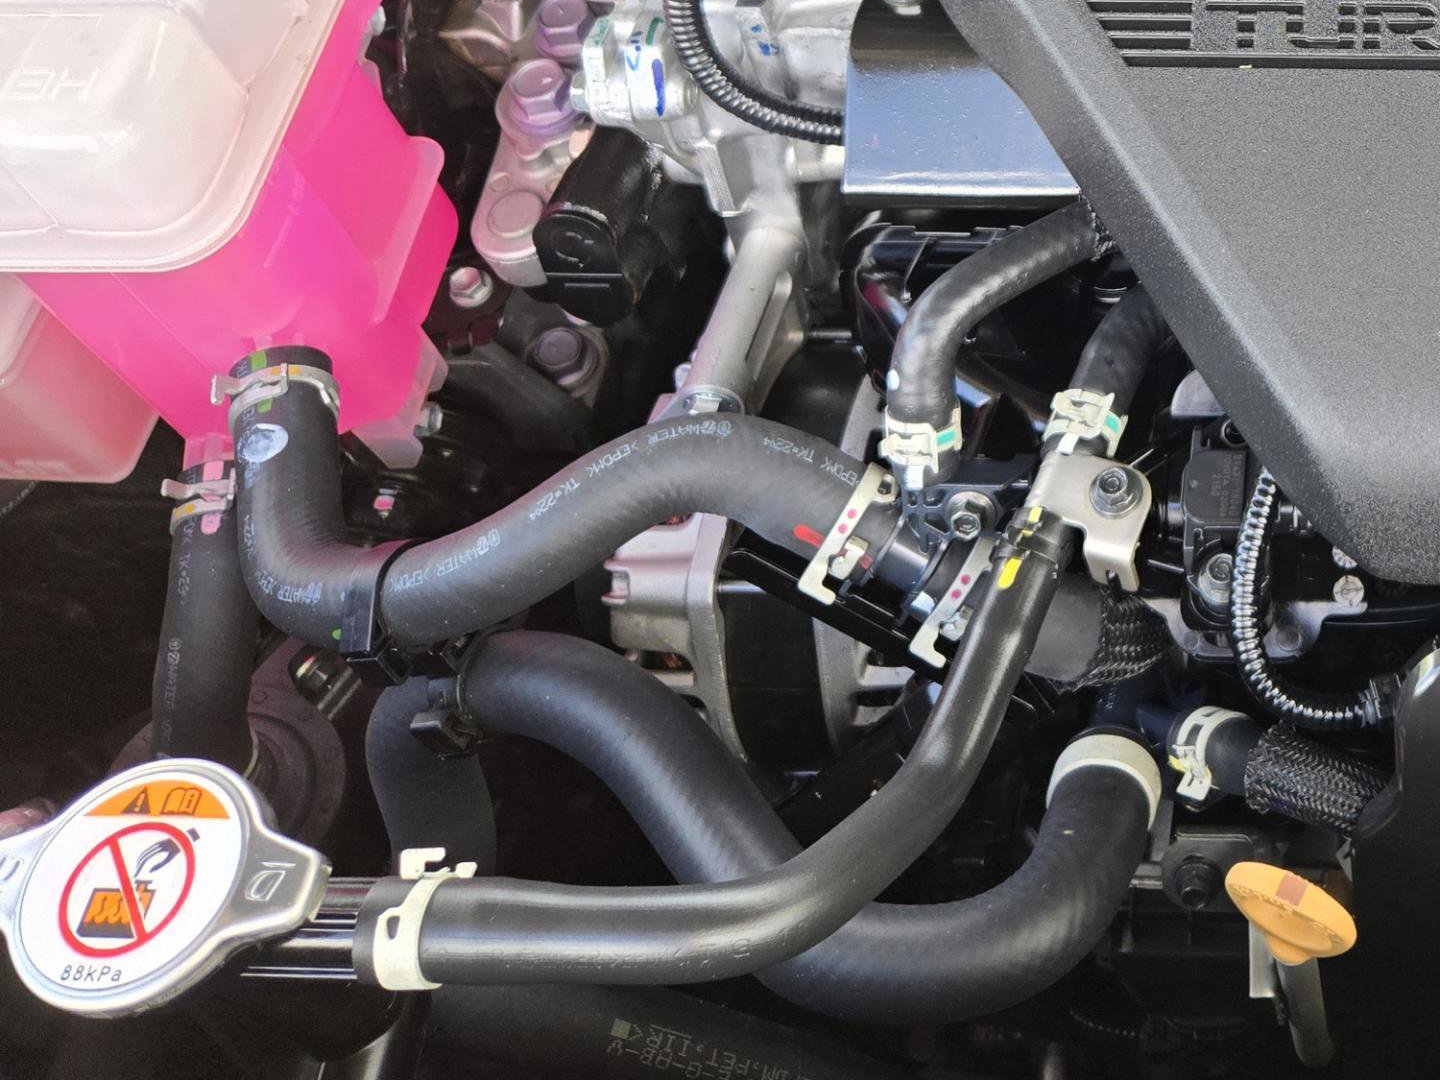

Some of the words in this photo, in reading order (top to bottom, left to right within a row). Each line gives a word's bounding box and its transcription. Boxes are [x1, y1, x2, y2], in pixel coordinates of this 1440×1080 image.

[648, 425, 700, 446] WATER
[436, 547, 478, 576] WATER
[60, 964, 122, 982] 88kPa
